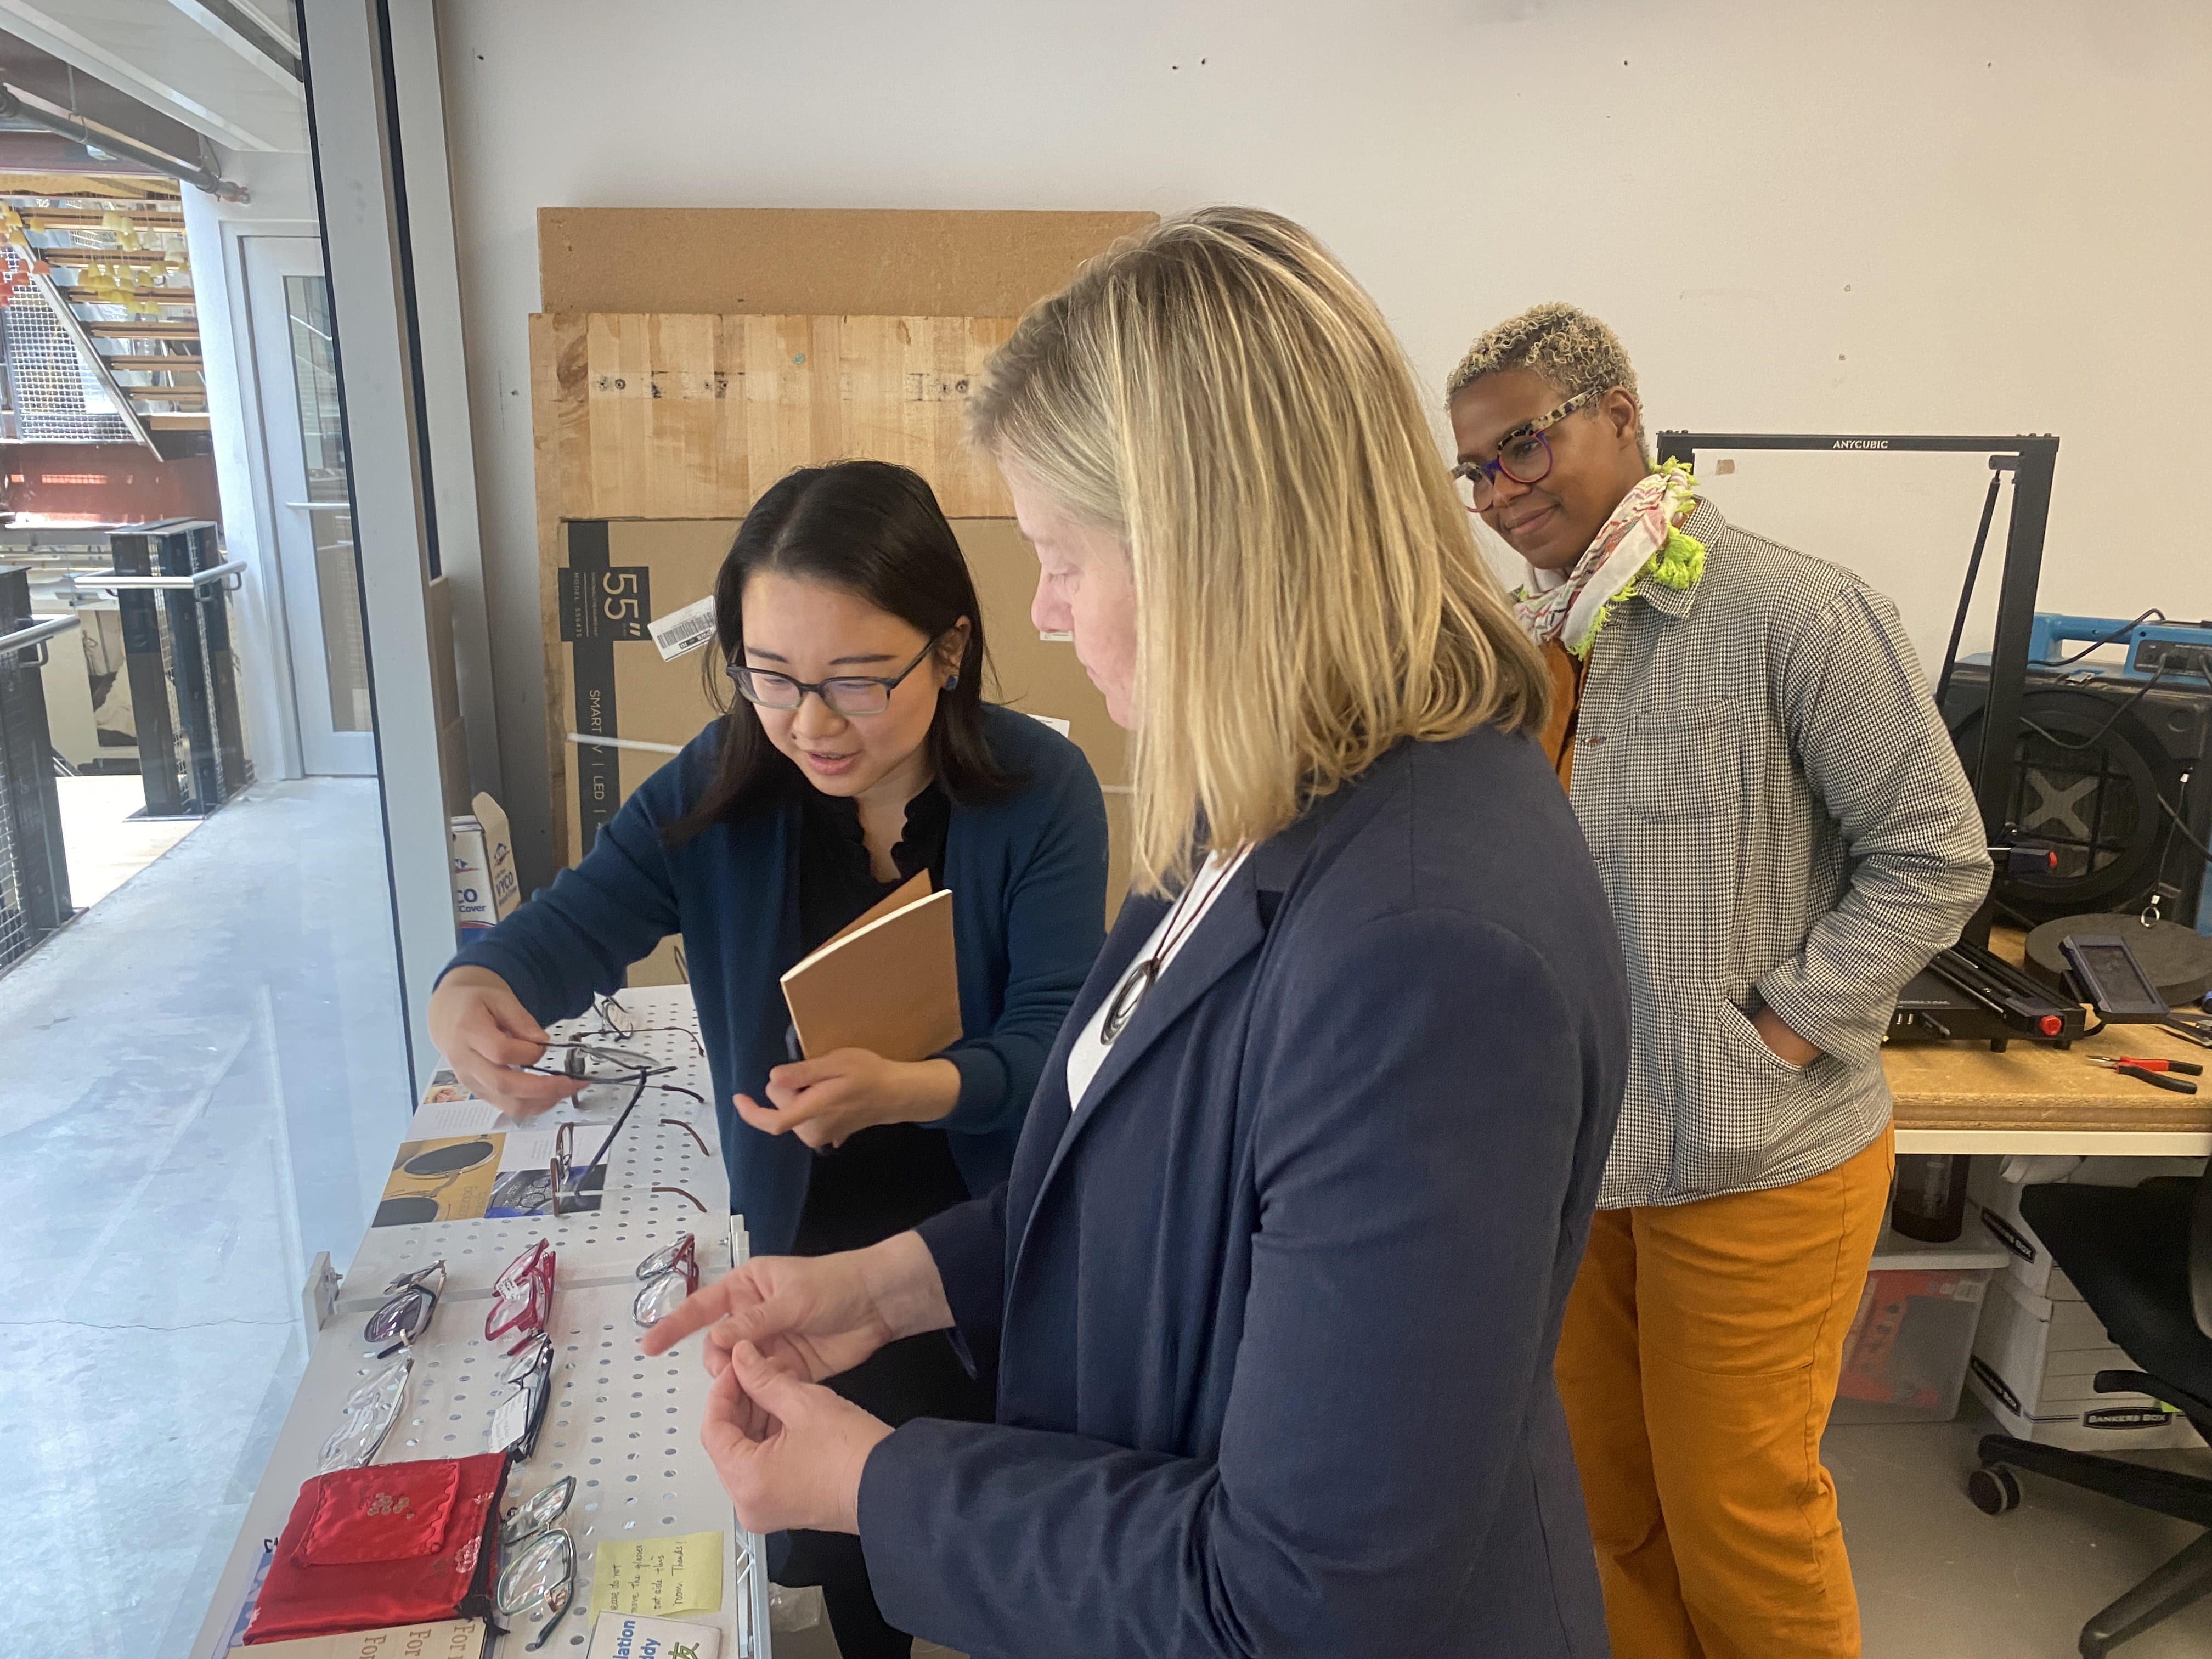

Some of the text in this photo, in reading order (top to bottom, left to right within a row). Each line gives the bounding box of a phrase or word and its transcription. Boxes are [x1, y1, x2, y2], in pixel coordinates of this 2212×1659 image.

[1833, 440, 1889, 449] ANYCUBIC
[590, 690, 602, 733] SMART
[594, 776, 605, 800] LED
[405, 1629, 432, 1656] For
[450, 1623, 476, 1651] For
